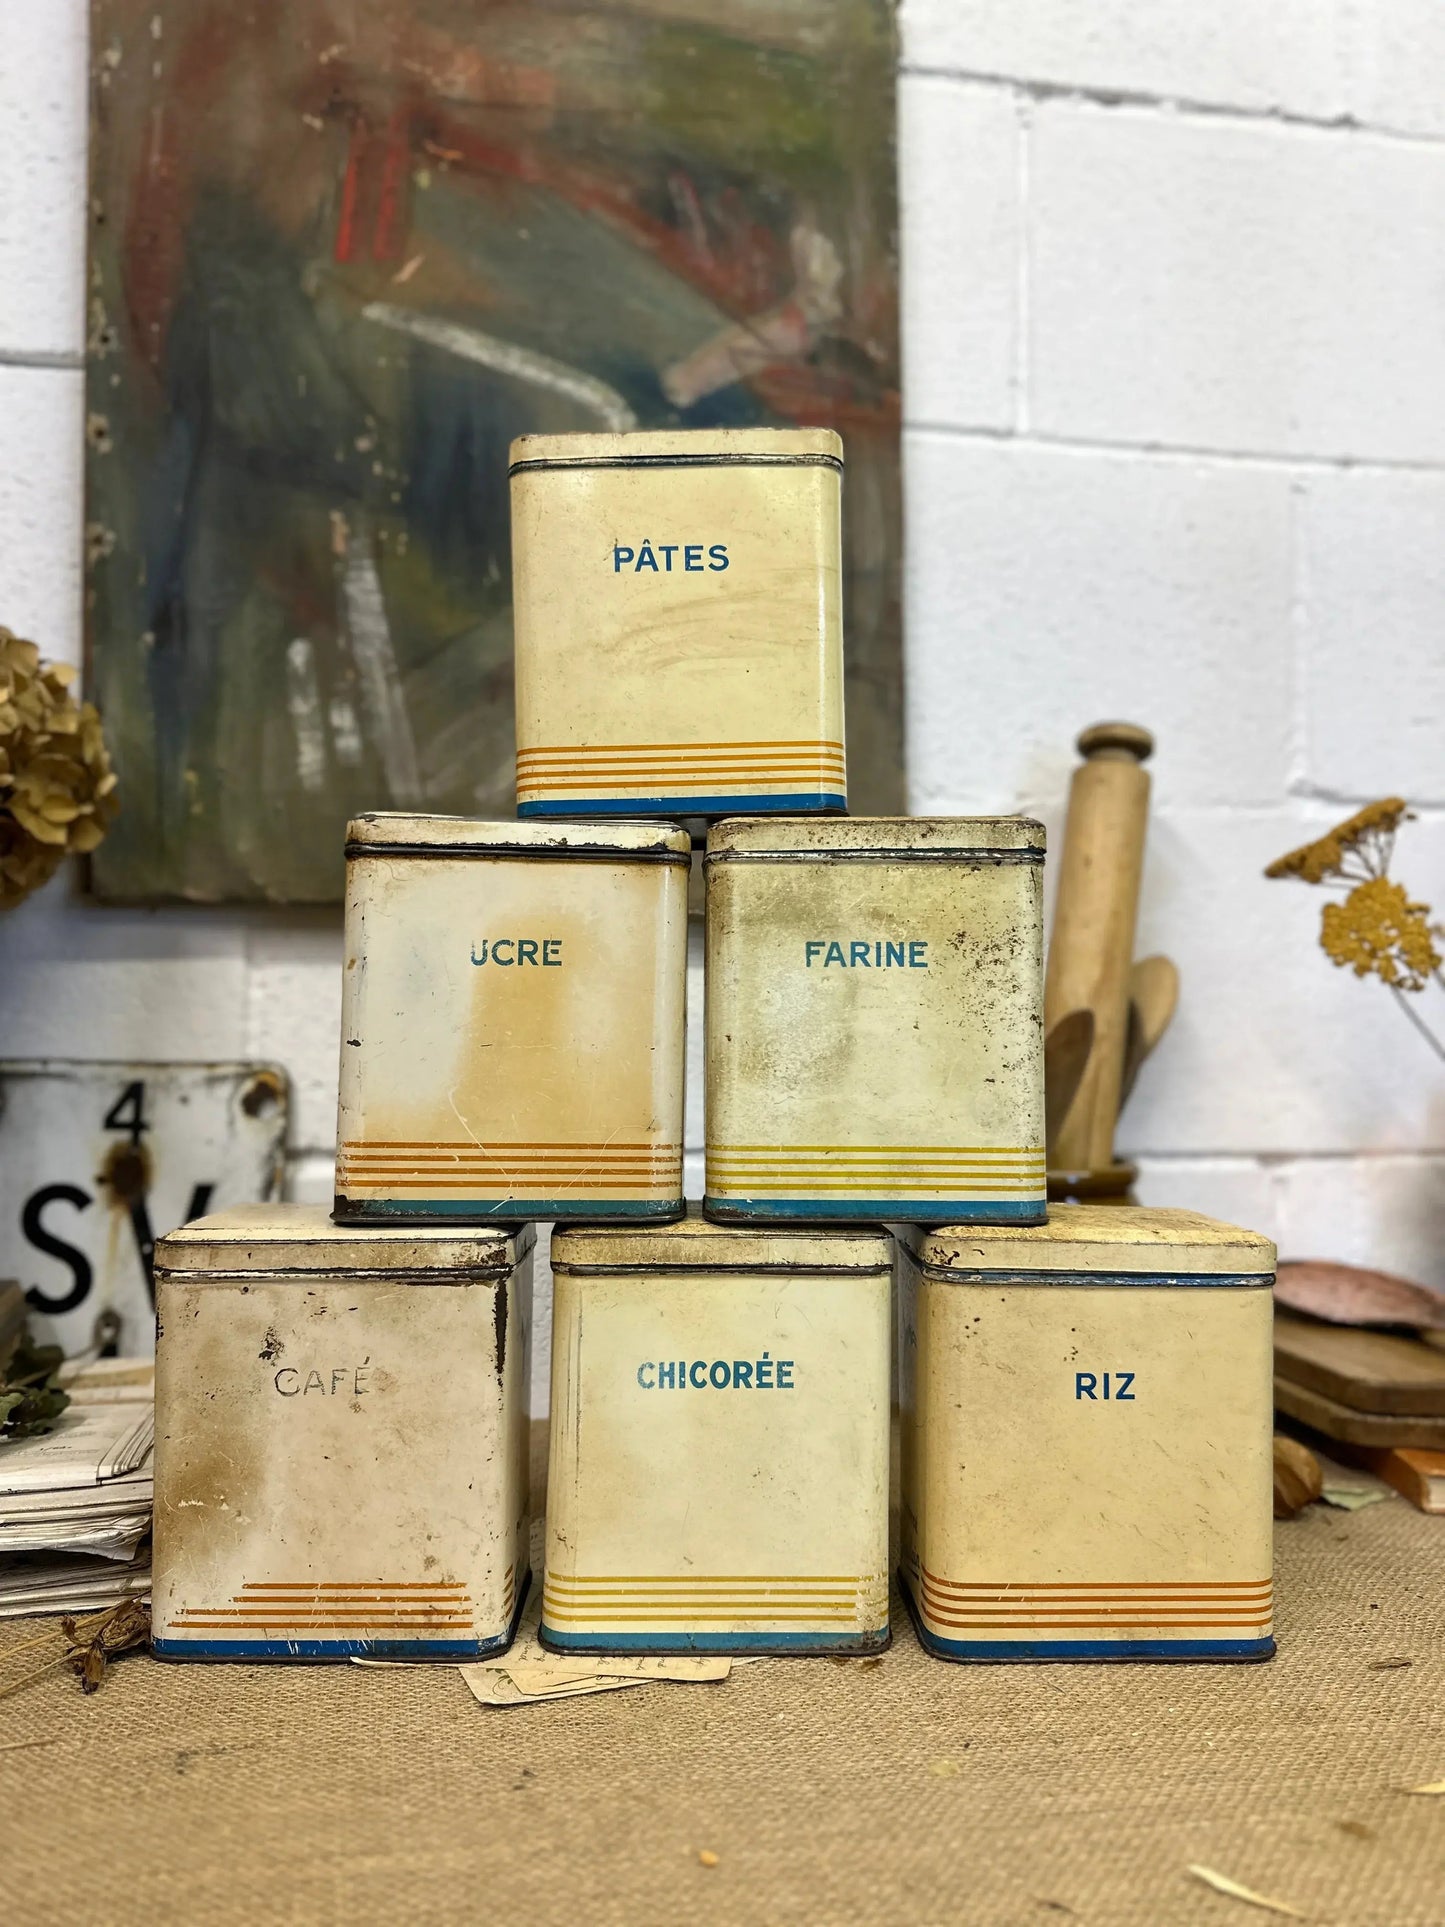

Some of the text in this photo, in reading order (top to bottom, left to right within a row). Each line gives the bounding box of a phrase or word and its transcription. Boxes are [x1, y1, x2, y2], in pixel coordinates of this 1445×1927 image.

[614, 538, 729, 572] PÂTES
[805, 941, 928, 967] FARINE
[104, 1081, 148, 1148] 4
[274, 1356, 371, 1396] CAFÉ
[637, 1351, 795, 1389] CHICORÉE
[1075, 1372, 1136, 1400] RIZ
